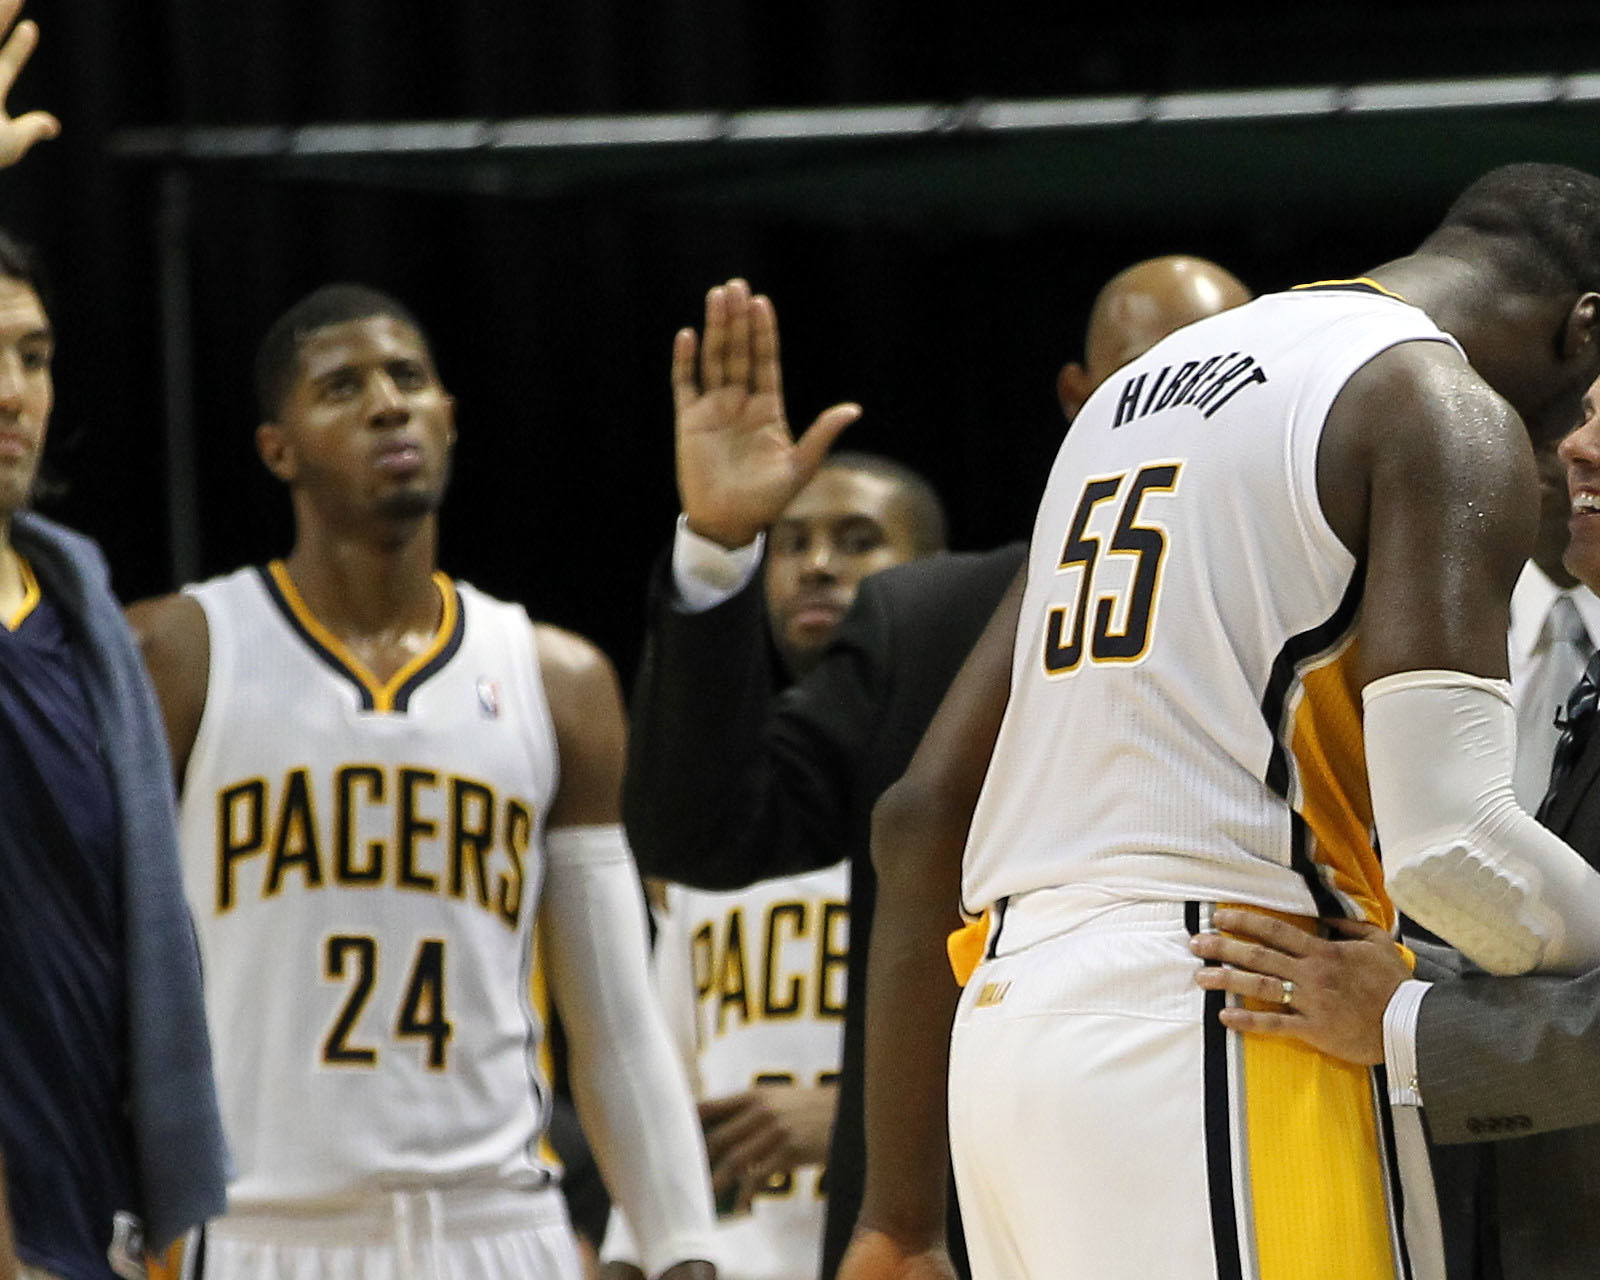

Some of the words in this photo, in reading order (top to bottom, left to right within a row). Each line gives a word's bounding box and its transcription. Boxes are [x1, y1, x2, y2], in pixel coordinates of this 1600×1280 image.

[1112, 352, 1267, 429] HIBBERT
[1043, 458, 1186, 678] 55
[215, 764, 531, 929] PACERS
[322, 935, 453, 1070] 24
